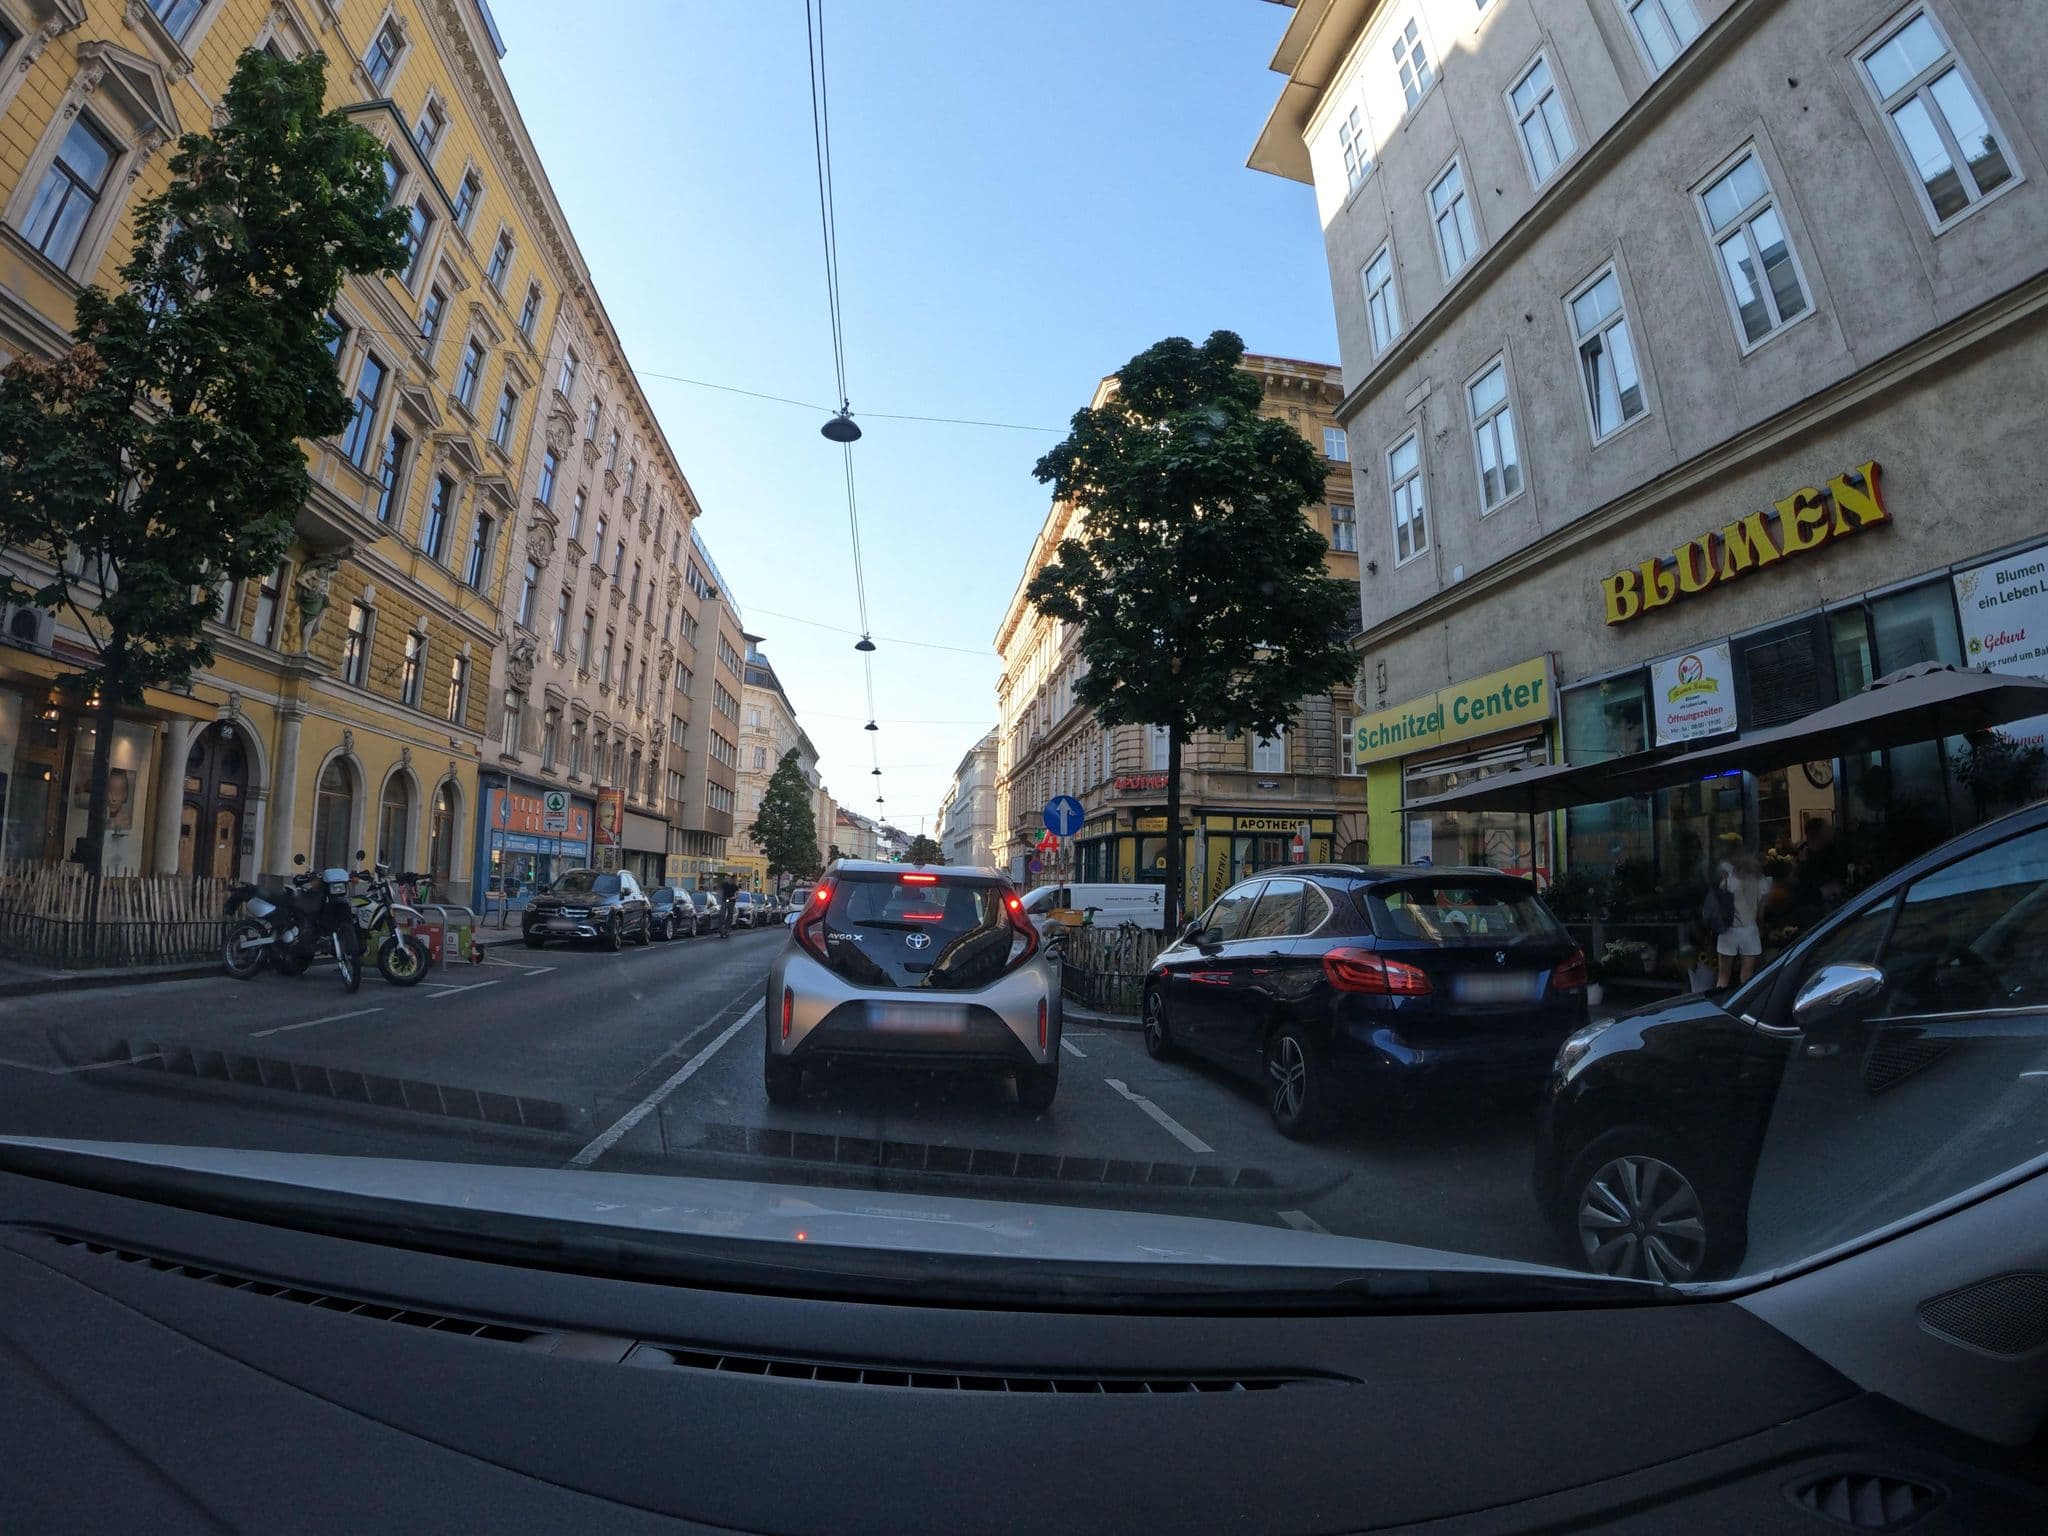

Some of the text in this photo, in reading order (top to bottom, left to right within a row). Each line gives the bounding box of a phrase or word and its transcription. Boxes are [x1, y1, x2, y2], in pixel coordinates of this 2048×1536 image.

[1601, 460, 1891, 626] BLUMEN
[1996, 562, 2045, 585] Blumen
[1979, 596, 1998, 610] ein
[2000, 584, 2038, 603] Leben
[1985, 628, 2026, 653] Geburt
[1998, 653, 2018, 666] rund
[2019, 651, 2034, 661] um
[1358, 678, 1543, 751] Schnitzel Center
[1667, 706, 1723, 724] Öffnungszeiten
